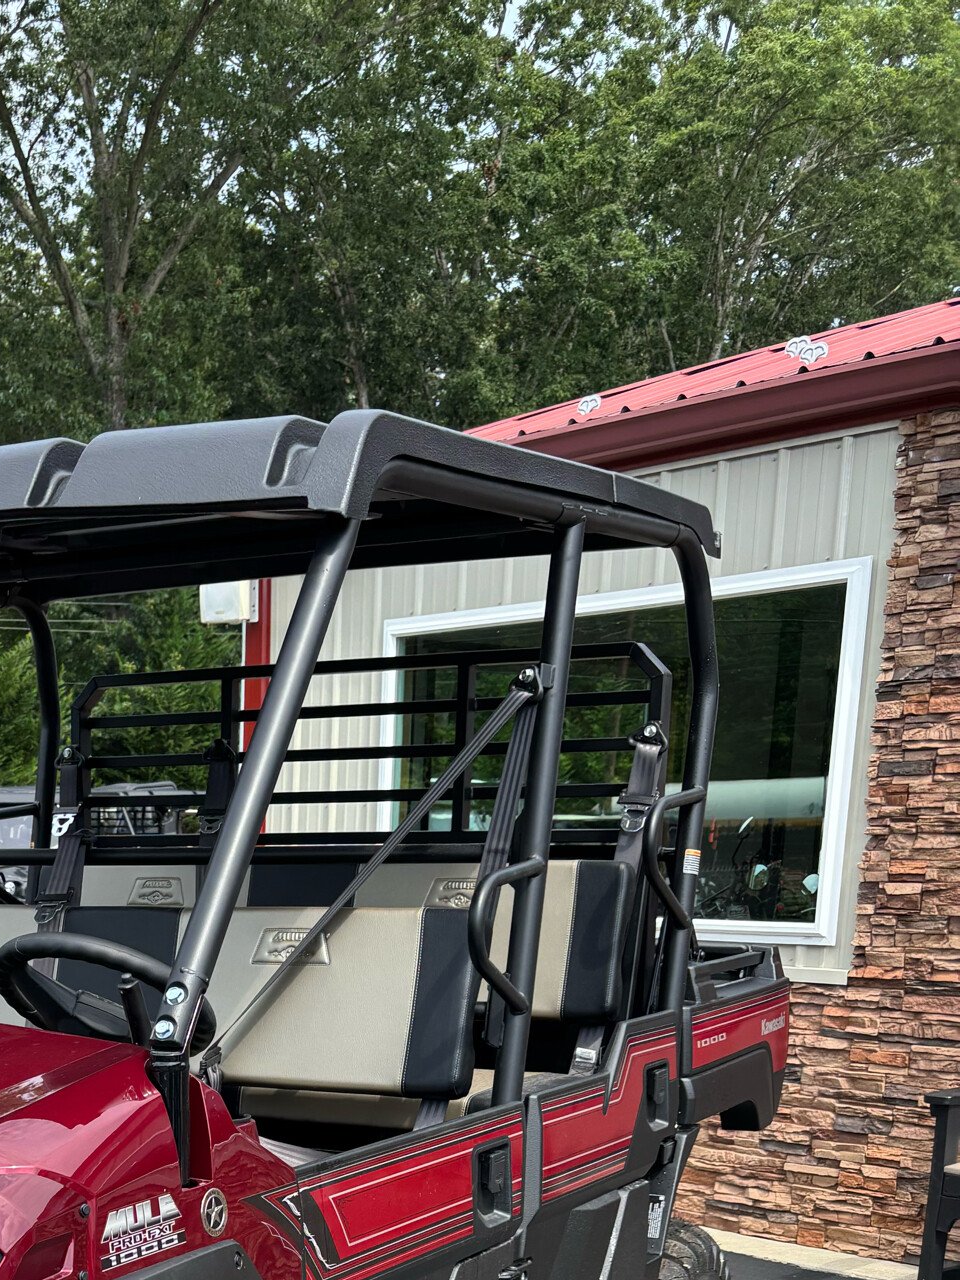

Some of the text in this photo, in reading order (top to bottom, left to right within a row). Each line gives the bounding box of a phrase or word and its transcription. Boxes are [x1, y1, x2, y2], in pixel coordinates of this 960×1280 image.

[697, 1033, 727, 1049] 1000
[101, 1193, 182, 1244] MULE
[109, 1235, 179, 1267] 1000
